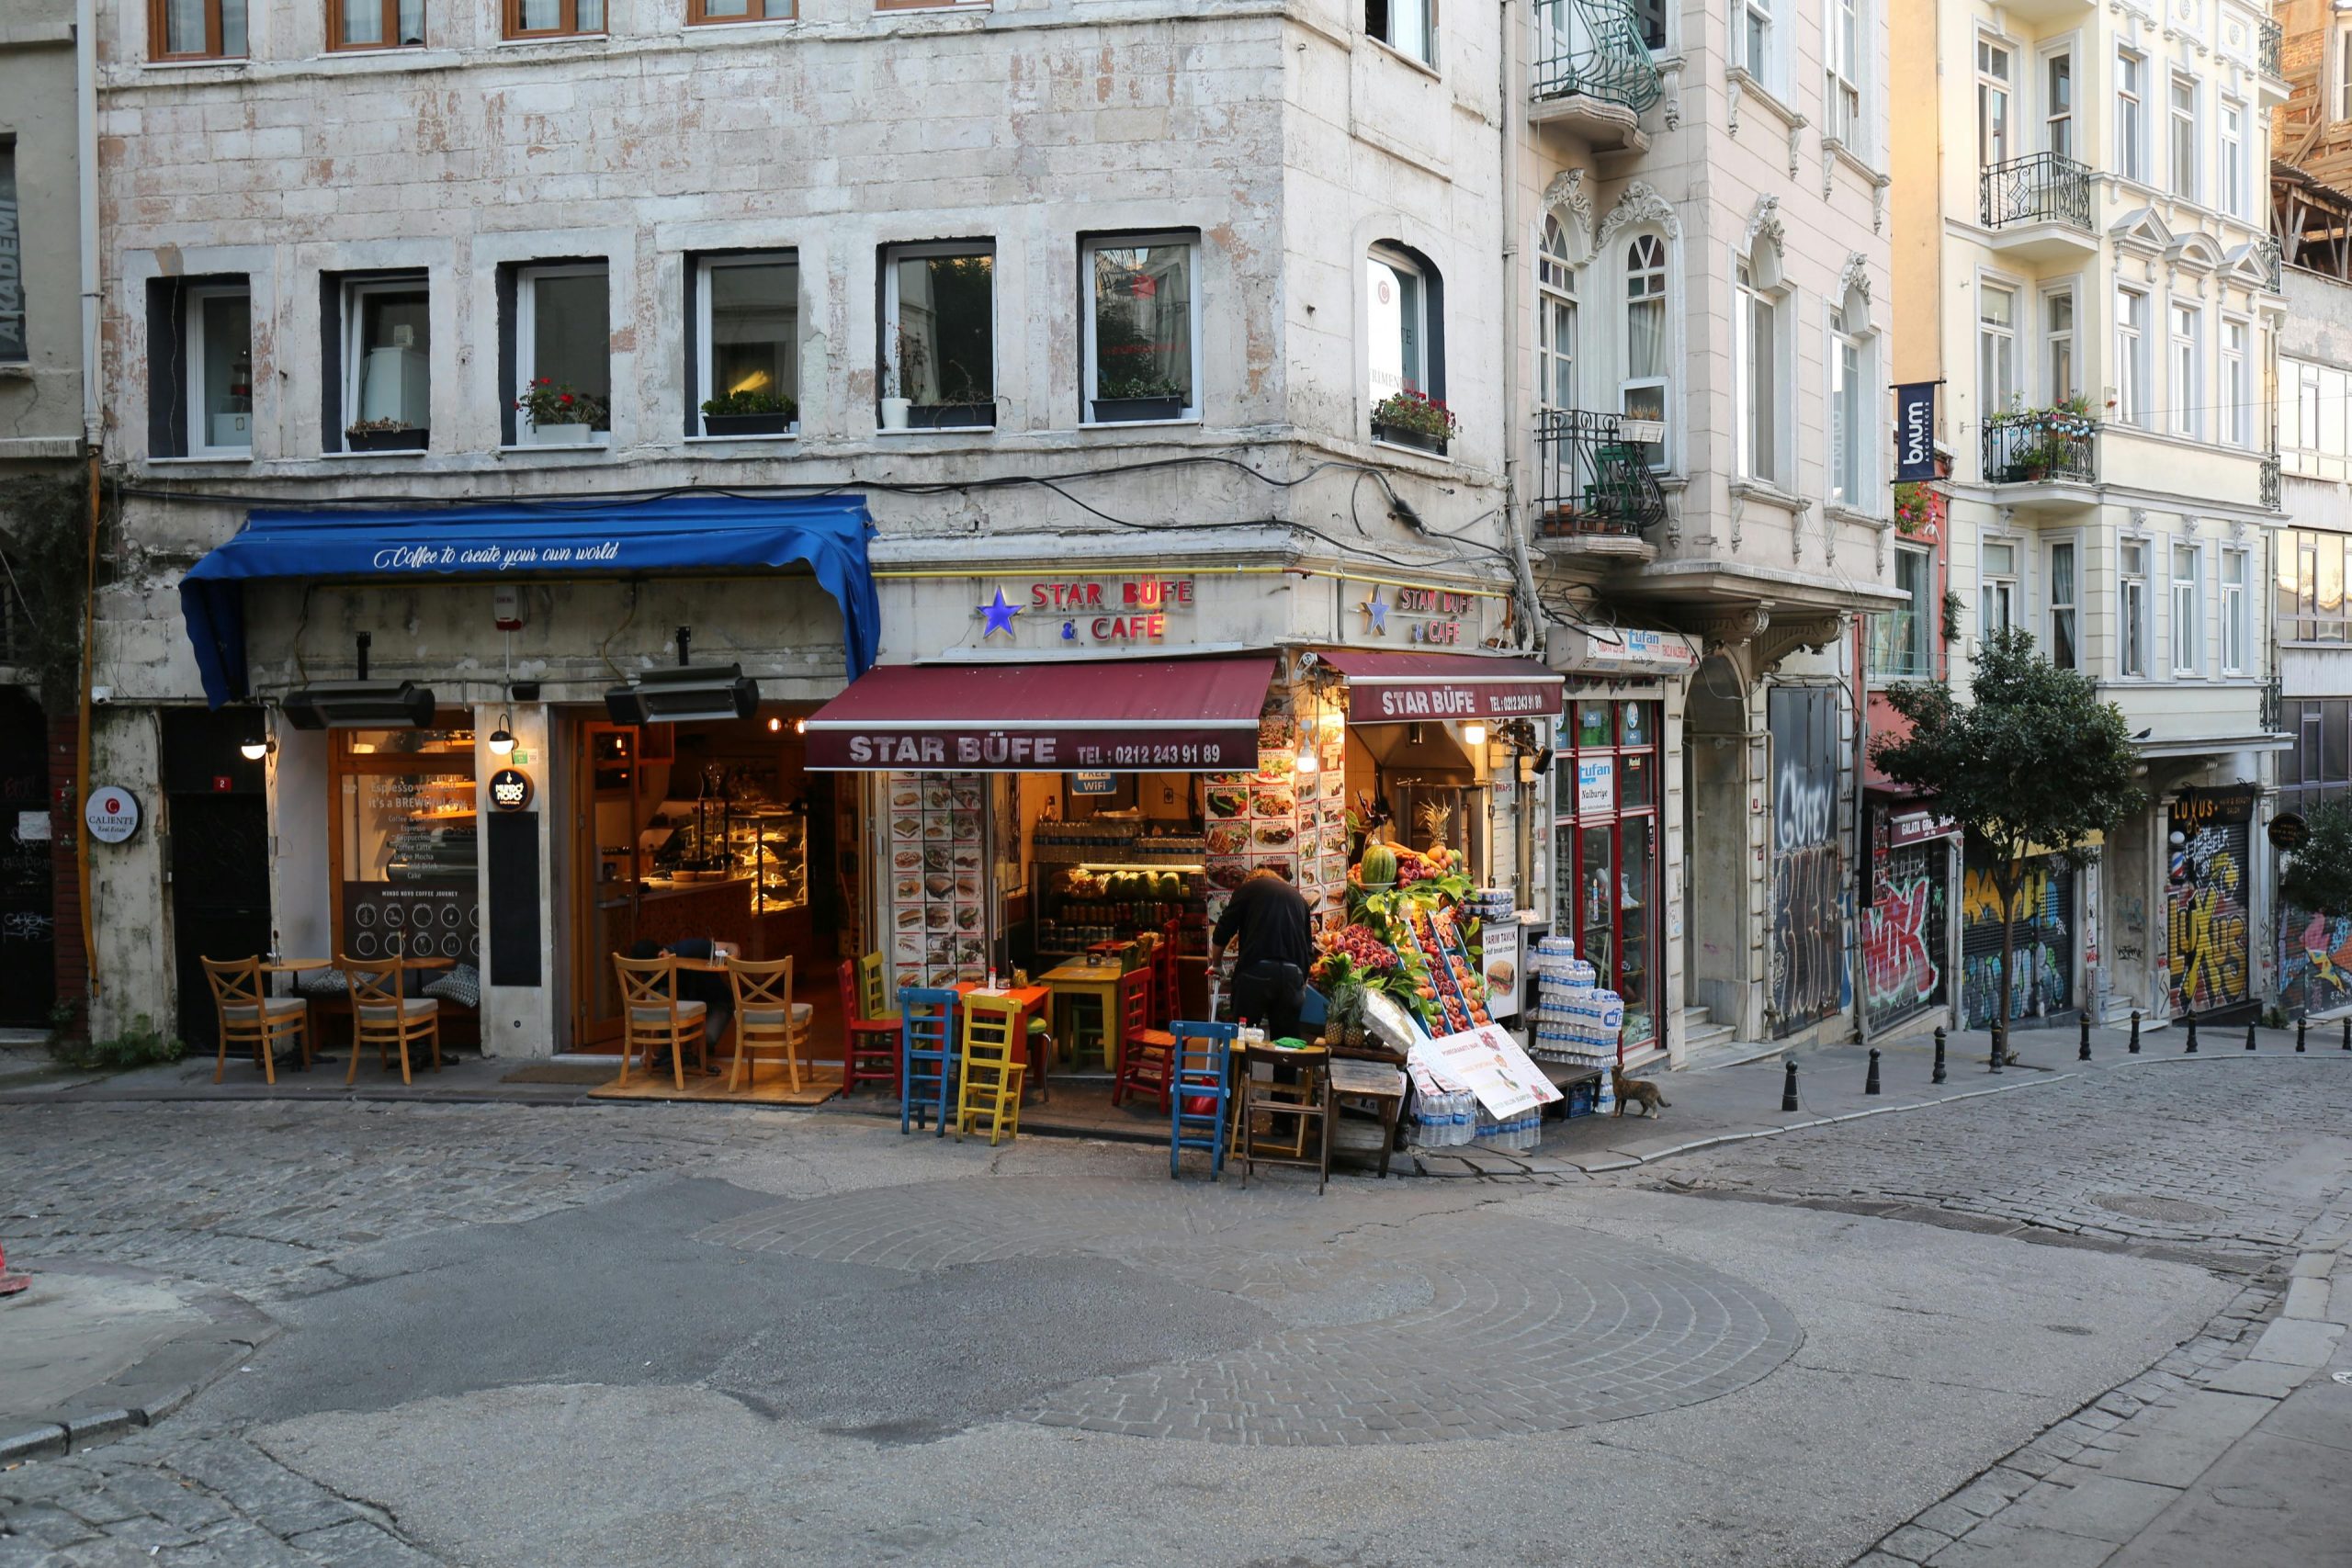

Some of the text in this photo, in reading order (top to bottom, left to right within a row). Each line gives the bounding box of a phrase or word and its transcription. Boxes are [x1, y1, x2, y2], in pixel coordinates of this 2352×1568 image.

[374, 541, 620, 570] Coffee to create your own world
[1031, 574, 1193, 607] STAR BÜFE
[1402, 587, 1437, 612] STAR
[1061, 608, 1164, 641] & CAFÉ
[1415, 624, 1424, 641] &
[1382, 690, 1430, 716] STAR
[1431, 685, 1476, 715] BÜFE
[1503, 695, 1517, 712] 0212
[1517, 695, 1528, 711] 243
[849, 736, 945, 763] STAR
[957, 731, 1057, 763] BÜFE
[1115, 745, 1149, 764] 0212
[1153, 745, 1179, 764] 243
[1182, 744, 1199, 763] 91
[1203, 743, 1220, 763] 89
[1578, 763, 1610, 785] tufan
[1084, 781, 1106, 791] WiFi
[1582, 787, 1608, 800] Nalburiye
[368, 796, 385, 808] it's
[387, 799, 392, 807] a
[88, 816, 134, 825] CALIENTE
